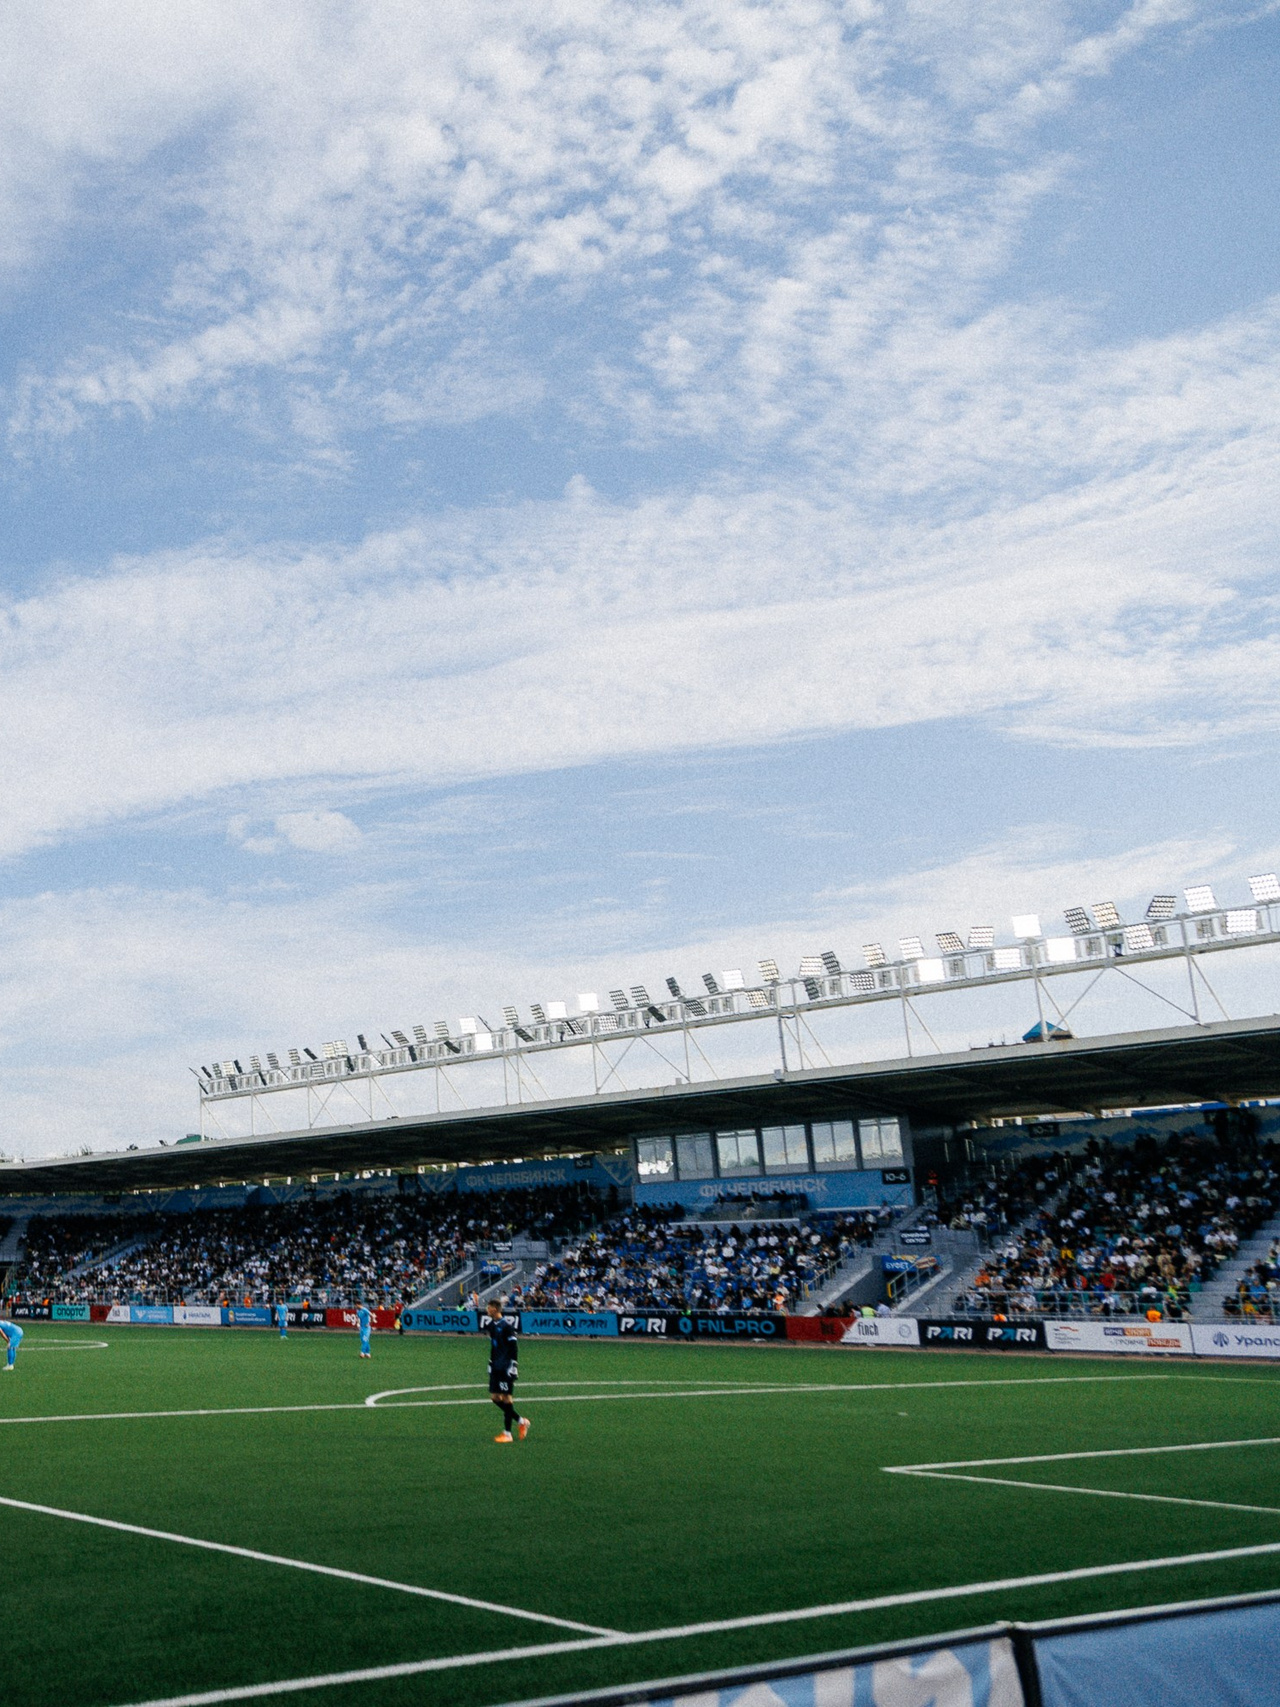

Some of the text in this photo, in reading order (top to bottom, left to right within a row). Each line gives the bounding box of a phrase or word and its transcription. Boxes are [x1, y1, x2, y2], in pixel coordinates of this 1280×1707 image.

[466, 1168, 567, 1187] ФК ЧЕЛЯБИНСК
[699, 1178, 829, 1198] ФК ЧЕЛЯБИНСК
[885, 1261, 909, 1270] БУФЕТ
[301, 1312, 324, 1322] PARI
[531, 1318, 561, 1328] ЛИГА
[620, 1317, 667, 1333] PARI
[926, 1326, 973, 1340] PARI
[986, 1327, 1037, 1342] PARI
[499, 1382, 508, 1391] 93
